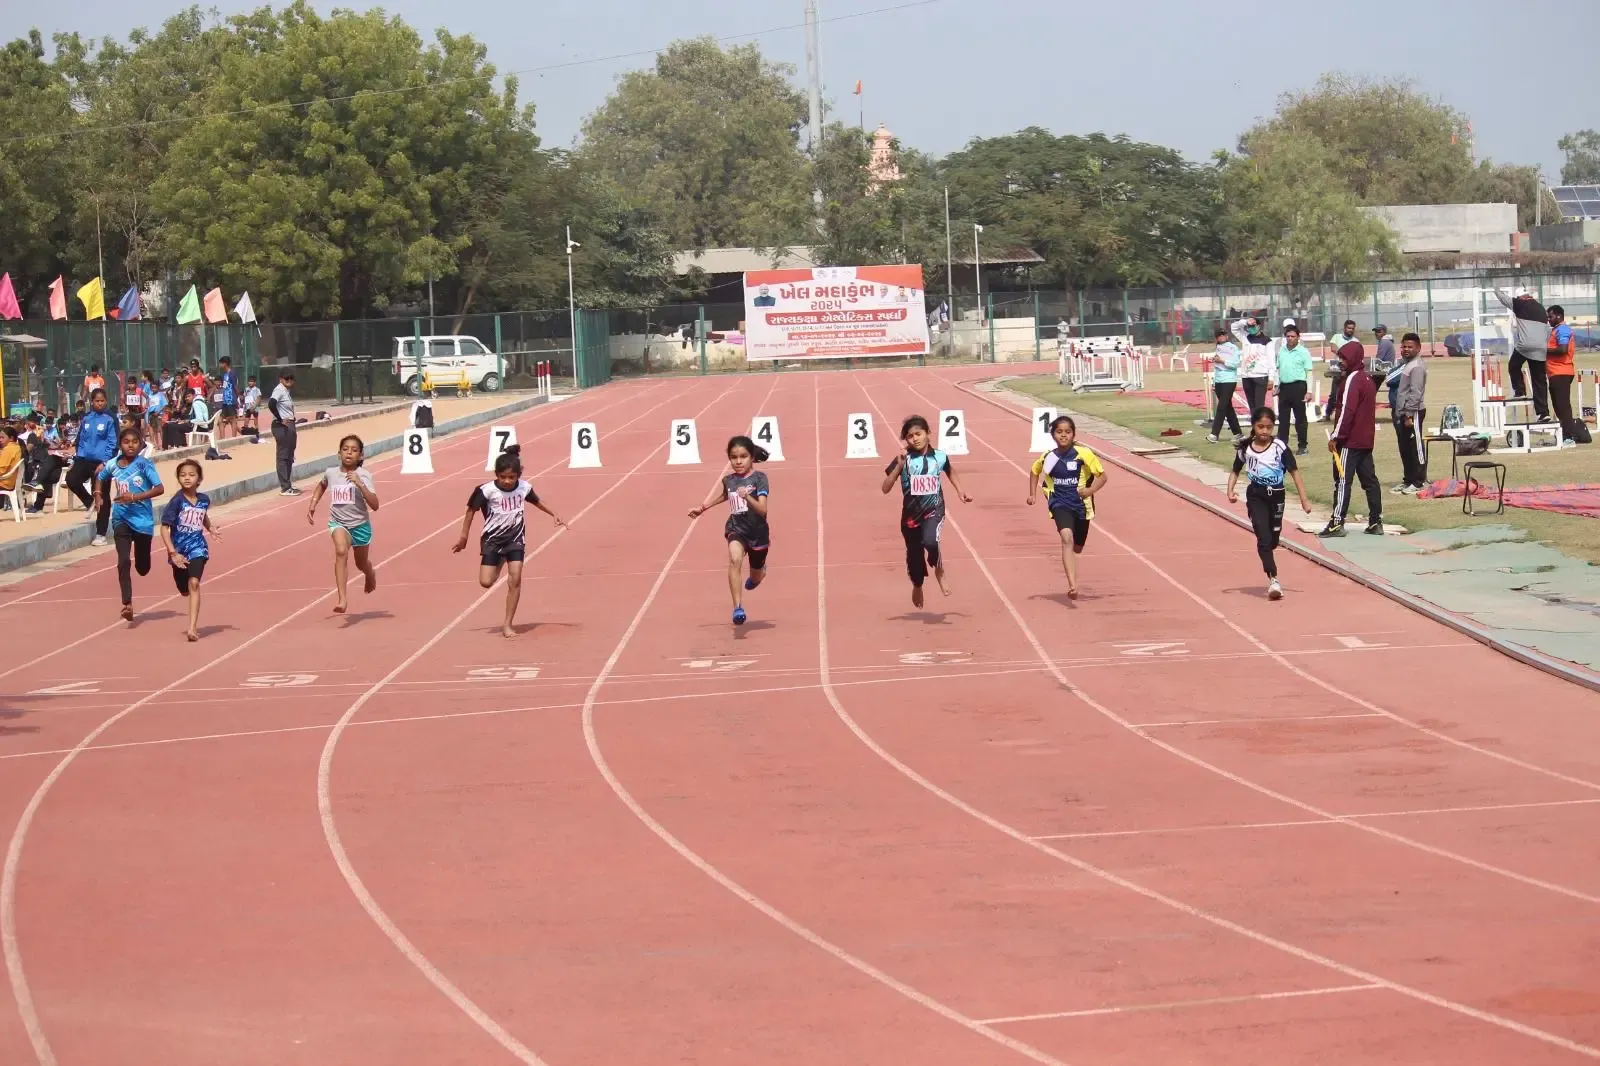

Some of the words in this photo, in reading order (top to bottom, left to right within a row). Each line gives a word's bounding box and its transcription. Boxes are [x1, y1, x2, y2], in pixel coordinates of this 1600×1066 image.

[780, 284, 810, 299] ખેલ
[814, 282, 874, 303] મહાકુંભ
[810, 300, 842, 310] ૨૦૨૫
[876, 309, 902, 321] સ્પર્ધા
[853, 418, 868, 440] 3
[945, 415, 960, 437] 2
[1039, 412, 1050, 433] 1
[577, 427, 593, 449] 6
[676, 424, 691, 446] 5
[757, 422, 772, 443] 4
[408, 434, 423, 455] 8
[495, 431, 510, 452] 7
[913, 476, 937, 492] 0838
[333, 487, 354, 501] 0661
[1112, 642, 1190, 655] 2
[1333, 636, 1390, 648] 1
[899, 651, 973, 664] 3
[465, 667, 540, 680] 5
[680, 660, 758, 672] 4
[239, 674, 319, 686] 6
